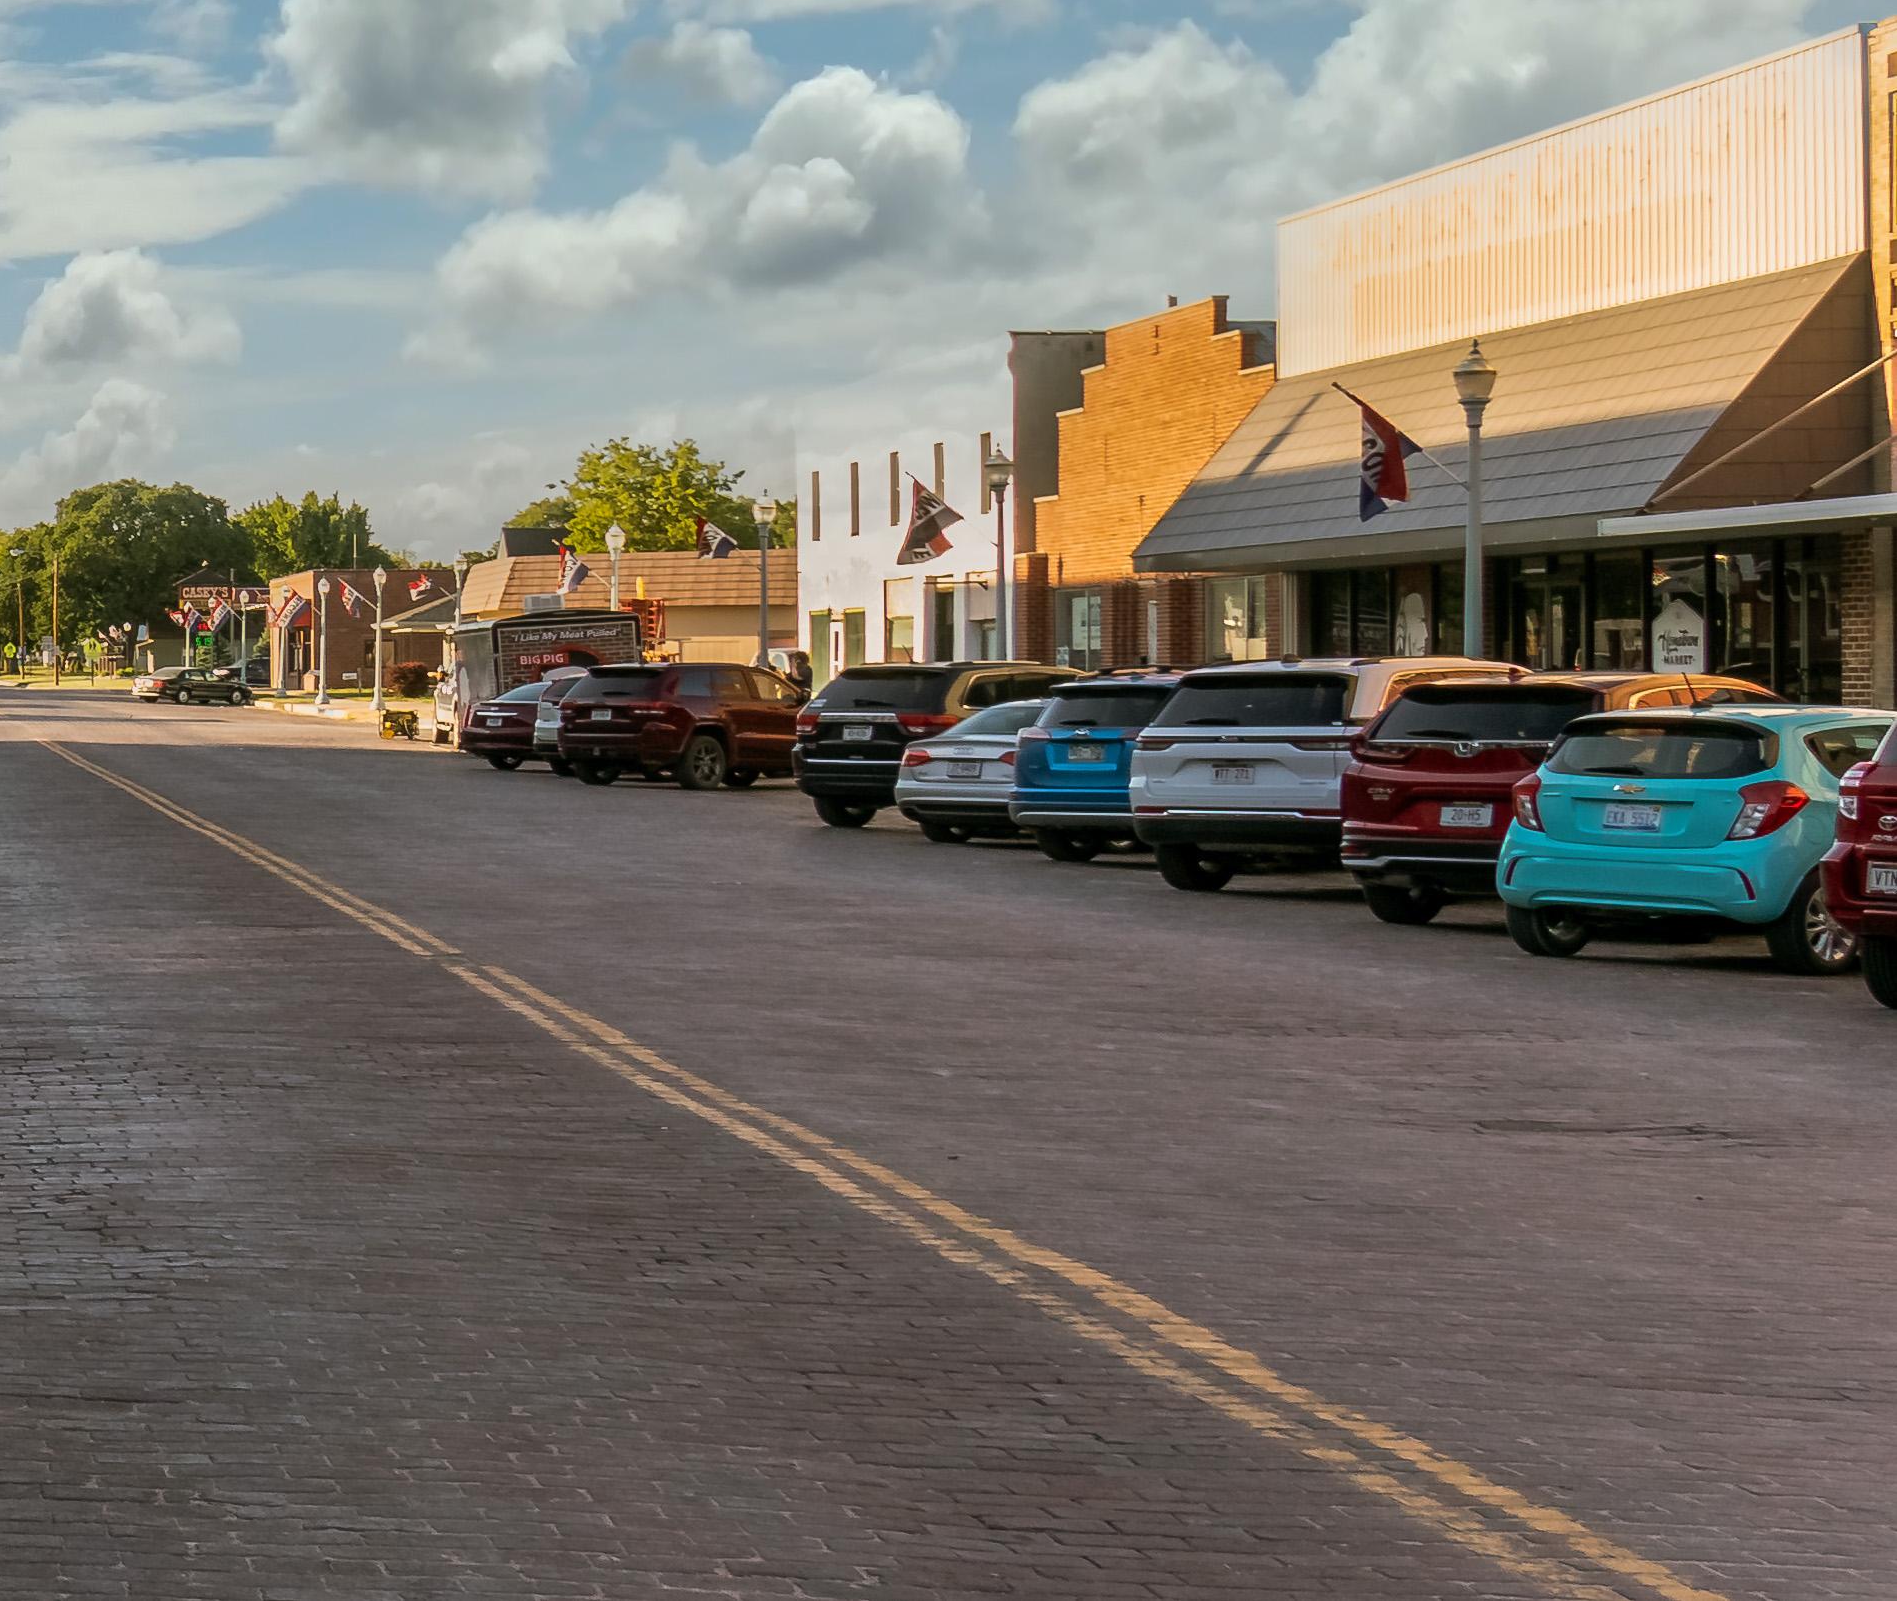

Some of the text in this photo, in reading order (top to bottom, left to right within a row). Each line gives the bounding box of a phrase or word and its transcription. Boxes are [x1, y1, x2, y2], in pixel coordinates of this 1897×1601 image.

[182, 587, 229, 598] CASEY'S
[520, 633, 539, 641] Like
[541, 632, 557, 641] My
[559, 631, 584, 639] Meat
[519, 654, 564, 665] BIG PIG
